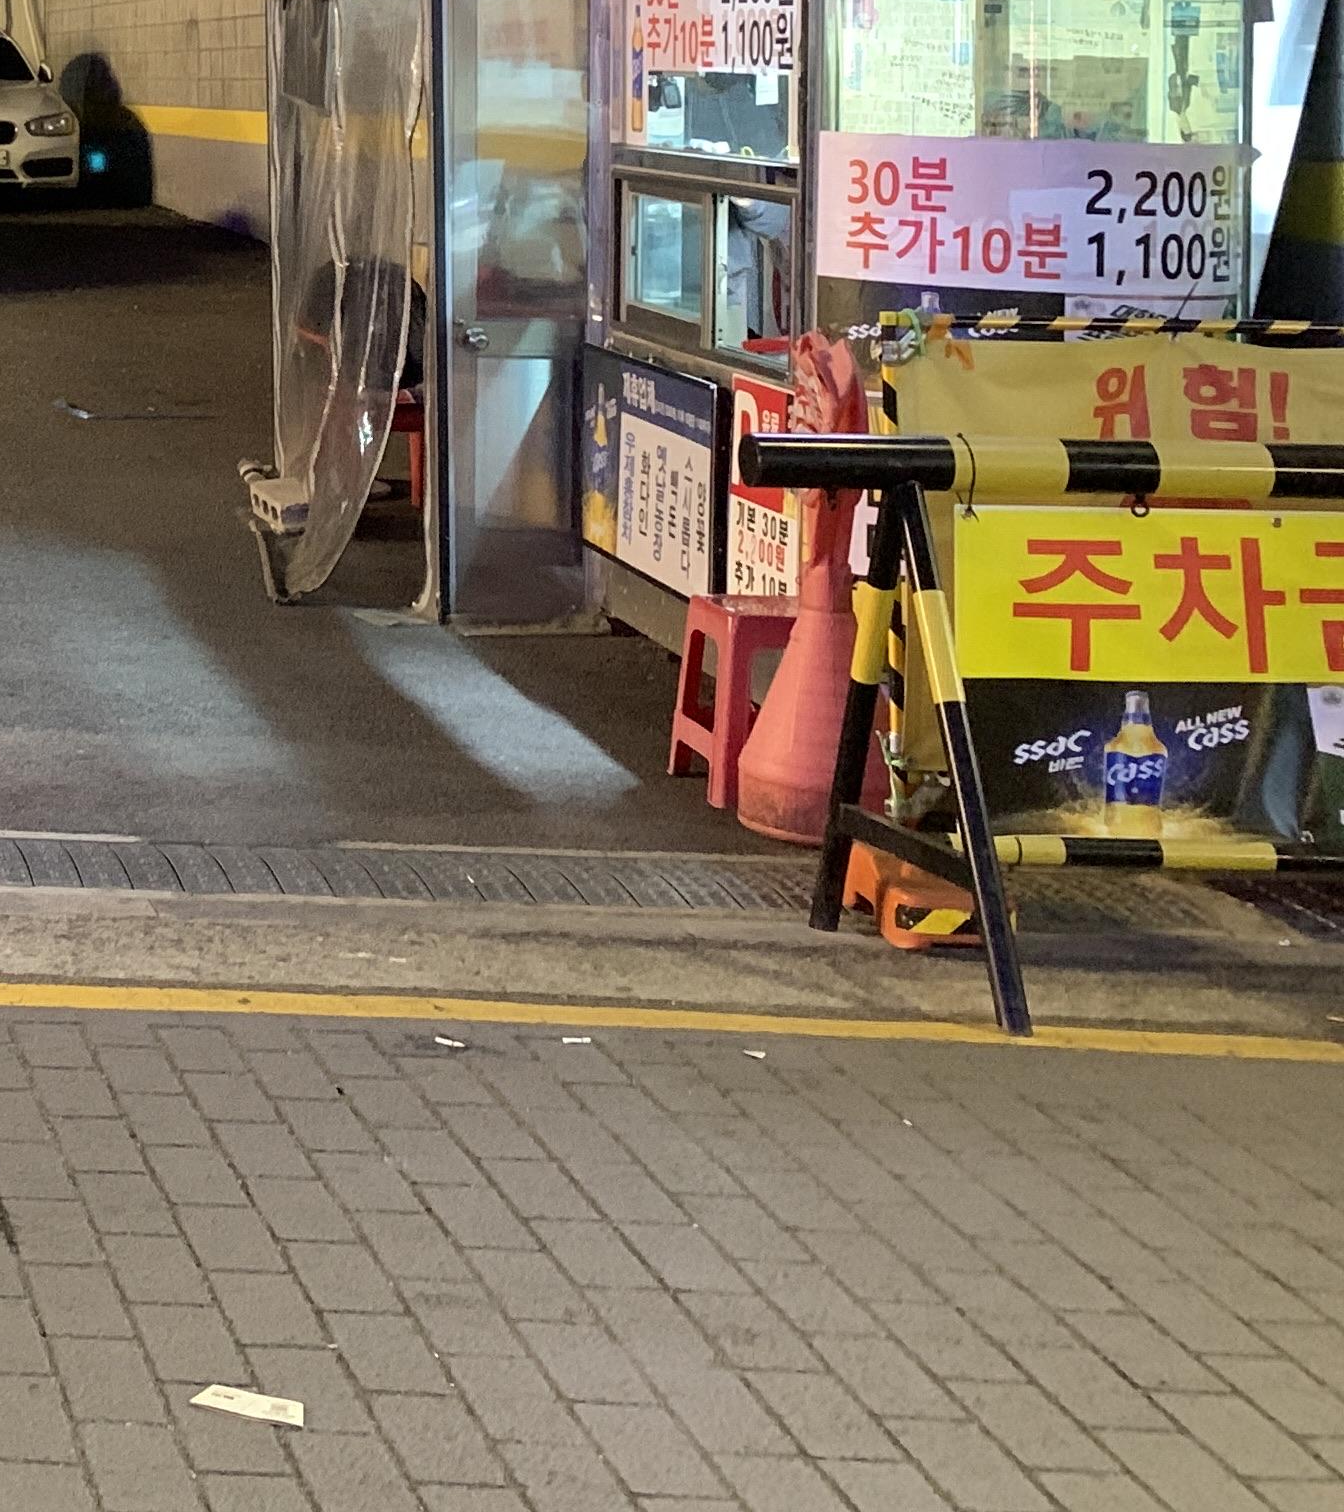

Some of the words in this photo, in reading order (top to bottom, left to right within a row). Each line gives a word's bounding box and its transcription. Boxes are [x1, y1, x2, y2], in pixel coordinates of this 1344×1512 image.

[720, 11, 794, 73] 1,100원
[846, 156, 954, 213] 30분
[1085, 165, 1232, 224] 2,200원
[1086, 226, 1231, 286] 1,100원
[736, 501, 756, 533] 기본
[762, 512, 789, 547] 30분
[1175, 715, 1206, 735] ALL
[1206, 705, 1243, 725] NEW
